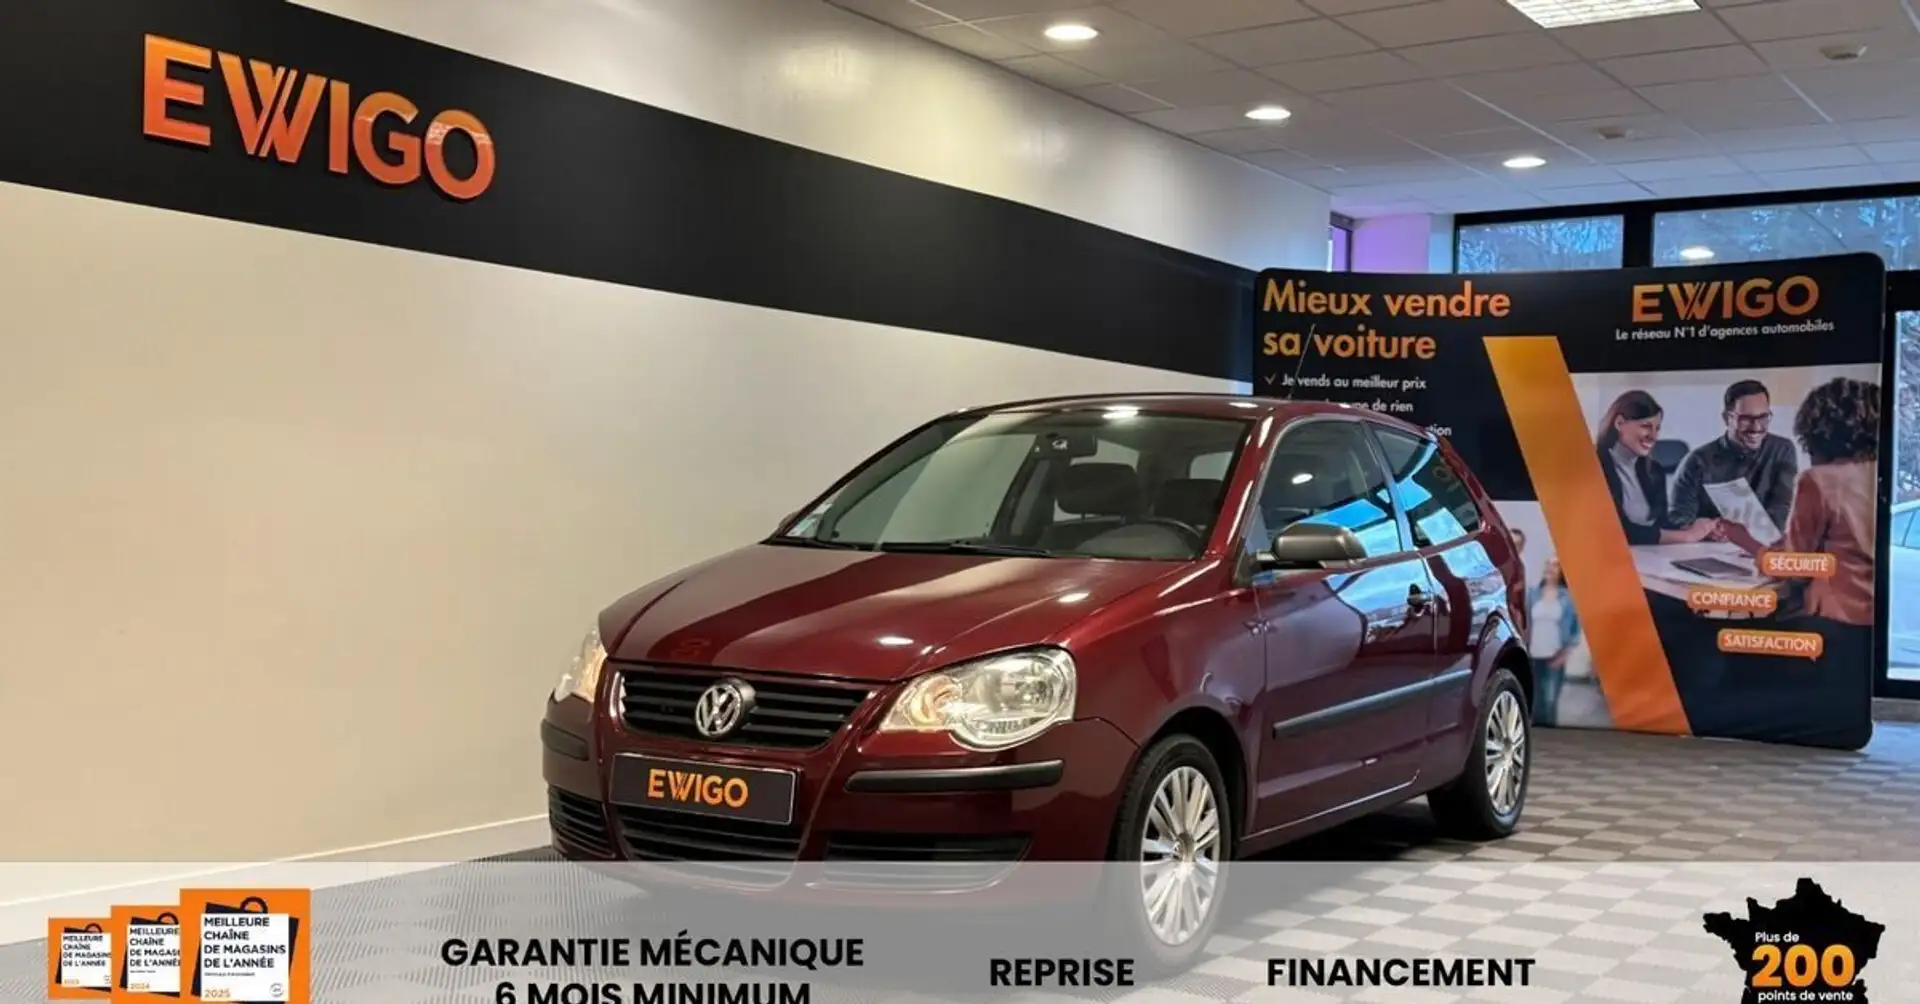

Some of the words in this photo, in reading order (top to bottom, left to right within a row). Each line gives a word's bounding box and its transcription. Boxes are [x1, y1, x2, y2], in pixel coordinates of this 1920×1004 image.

[143, 33, 496, 200] EWIGO
[1263, 278, 1373, 316] Mieux
[1383, 280, 1512, 317] vendre
[1632, 275, 1820, 323] EWIGO
[1615, 328, 1629, 340] Le
[1631, 327, 1671, 340] réseau
[1698, 323, 1759, 340] d'agences
[1761, 318, 1836, 334] automobiles
[1263, 331, 1301, 356] sa
[1313, 323, 1437, 359] voiture
[1281, 374, 1296, 387] Je
[1298, 374, 1331, 388] vends
[1333, 377, 1350, 388] au
[1352, 375, 1399, 389] meilleur
[1402, 376, 1427, 392] prix
[1372, 398, 1387, 412] de
[1390, 399, 1414, 413] rien
[1769, 556, 1829, 572] SÉCURITÉ
[1691, 591, 1773, 608] CONFIANCE
[1723, 633, 1817, 651] SATISFACTION
[647, 768, 749, 808] EWIGO
